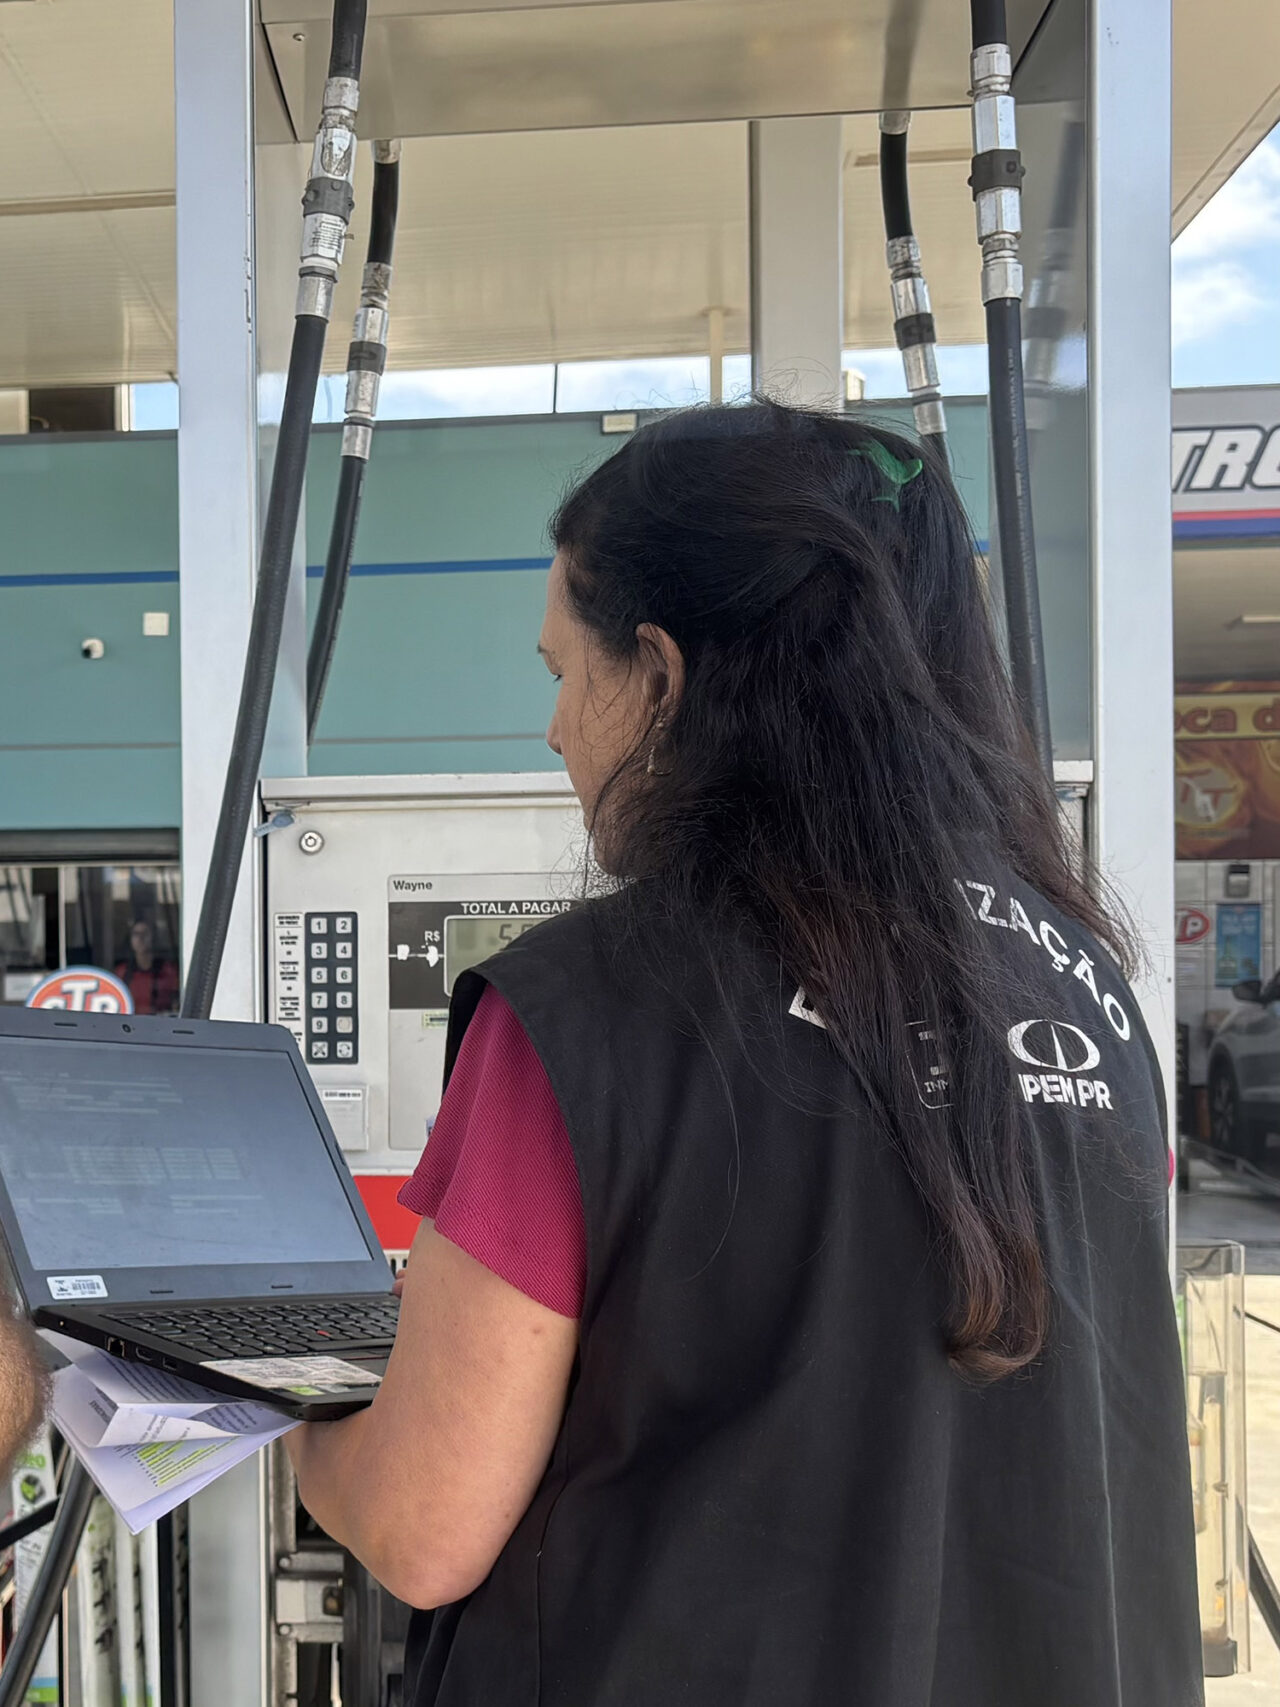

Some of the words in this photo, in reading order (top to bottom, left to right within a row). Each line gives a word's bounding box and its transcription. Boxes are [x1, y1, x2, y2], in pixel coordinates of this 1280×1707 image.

[393, 880, 433, 892] Wayne
[461, 902, 505, 914] TOTAL
[508, 902, 519, 913] A
[522, 901, 571, 914] PAGAR
[341, 920, 348, 931] 2
[424, 930, 440, 942] R$
[316, 945, 323, 956] 3
[340, 945, 348, 956] 4
[316, 970, 324, 981] 5
[341, 969, 348, 981] 6
[316, 995, 323, 1006] 7
[340, 995, 348, 1006] 8
[316, 1019, 323, 1031] 9
[1018, 1074, 1077, 1106] IPEM
[1076, 1079, 1114, 1111] PR
